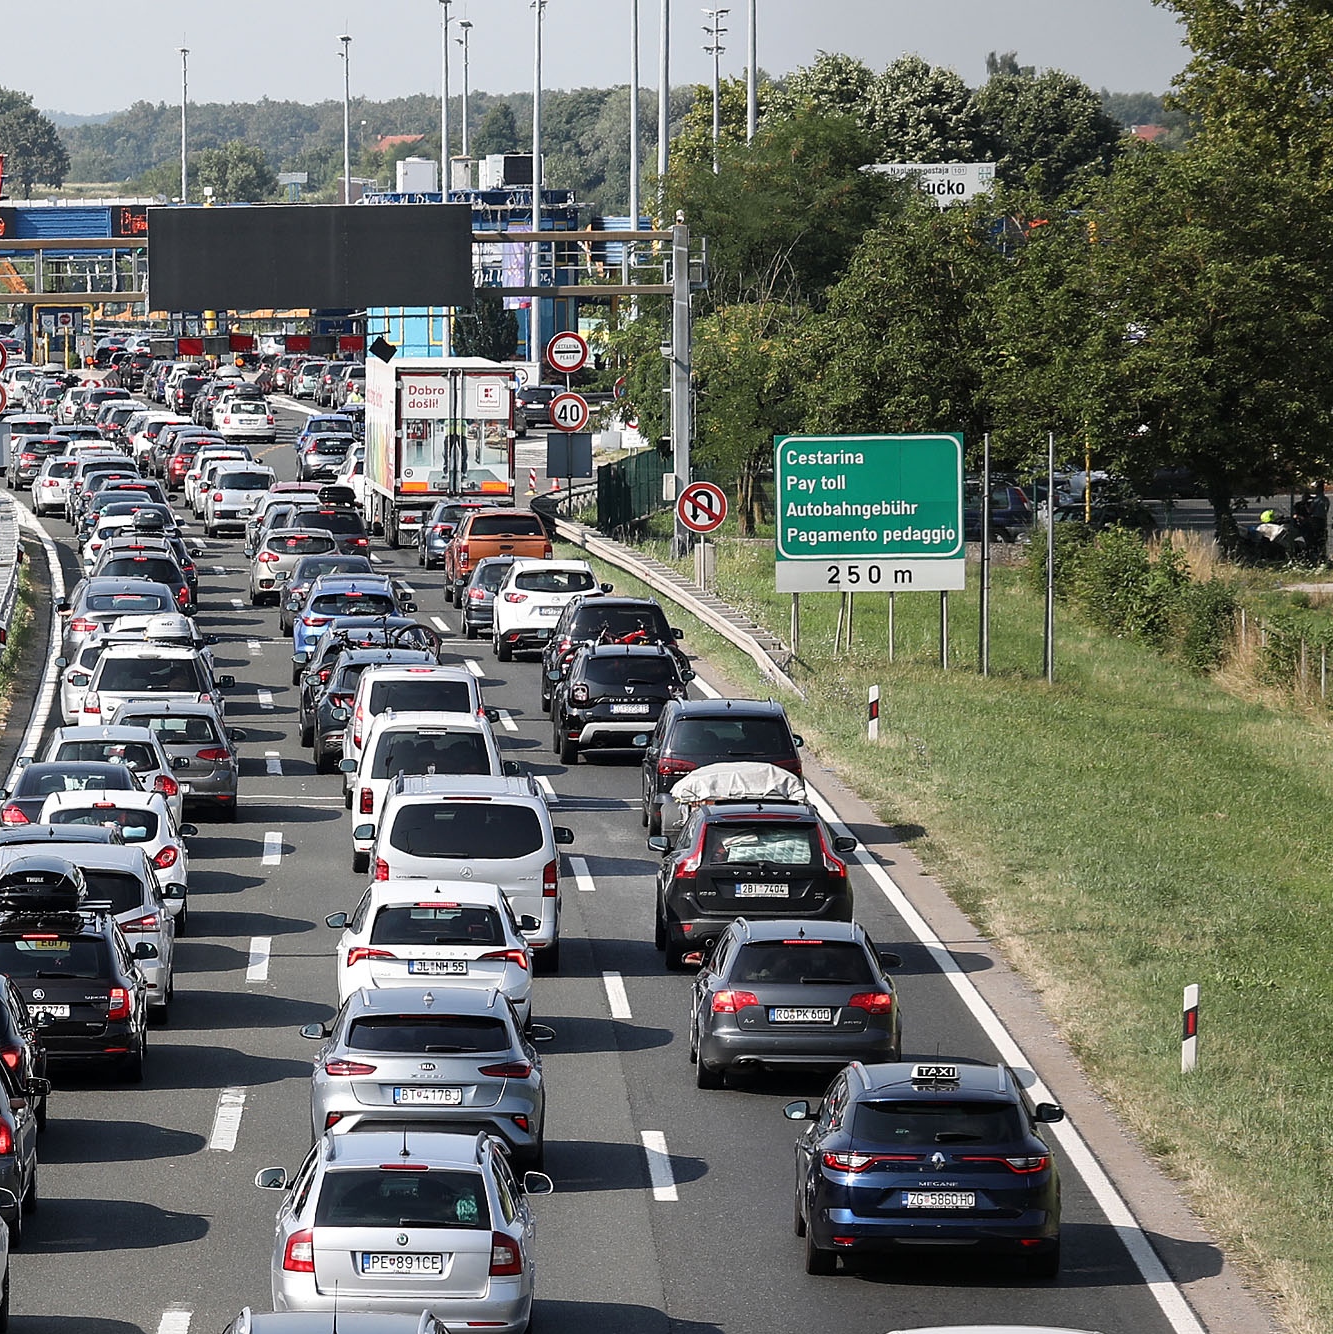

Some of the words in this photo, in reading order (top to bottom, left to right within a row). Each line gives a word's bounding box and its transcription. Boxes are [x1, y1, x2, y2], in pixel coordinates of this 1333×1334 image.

[927, 179, 965, 195] učko
[408, 385, 445, 396] Dobro
[408, 398, 439, 409] došli!
[558, 404, 580, 422] 40
[786, 450, 864, 465] Cestarina
[786, 475, 817, 494] Pay
[821, 475, 846, 490] toll
[786, 500, 918, 520] Autobahngebühr
[787, 527, 878, 545] Pagamento
[883, 525, 956, 545] pedaggio
[827, 565, 881, 584] 250
[894, 569, 913, 584] m
[764, 884, 784, 893] 7404
[435, 961, 448, 971] NH
[453, 961, 464, 971] 55
[796, 1009, 809, 1020] PK
[811, 1009, 830, 1020] 600
[919, 1067, 954, 1076] TAXI
[402, 1089, 416, 1101] BT
[909, 1193, 923, 1205] ZG
[371, 1256, 389, 1269] PE
[396, 1256, 440, 1270] 891CE
